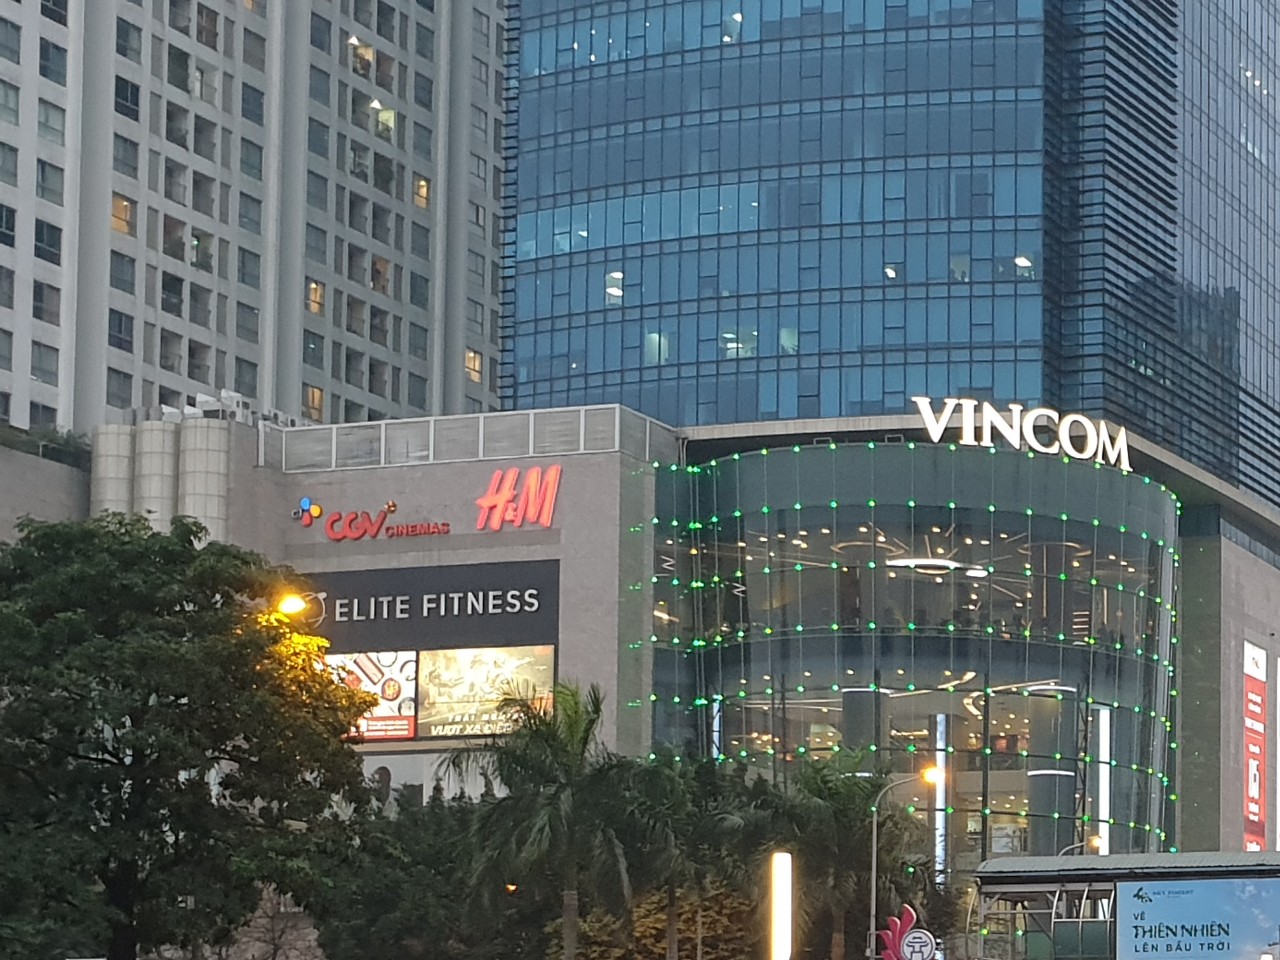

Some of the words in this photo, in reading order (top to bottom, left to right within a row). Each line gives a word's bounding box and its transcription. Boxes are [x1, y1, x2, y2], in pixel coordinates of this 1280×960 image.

[911, 396, 1133, 472] VINCOM
[475, 464, 562, 531] H&M
[324, 510, 387, 542] CGV
[385, 522, 450, 538] CINEMAS
[335, 596, 410, 621] ELITE
[422, 589, 539, 617] FITNESS
[1132, 922, 1178, 939] THIÊN
[1180, 921, 1230, 938] NHIÊN
[1134, 942, 1159, 953] LÊN
